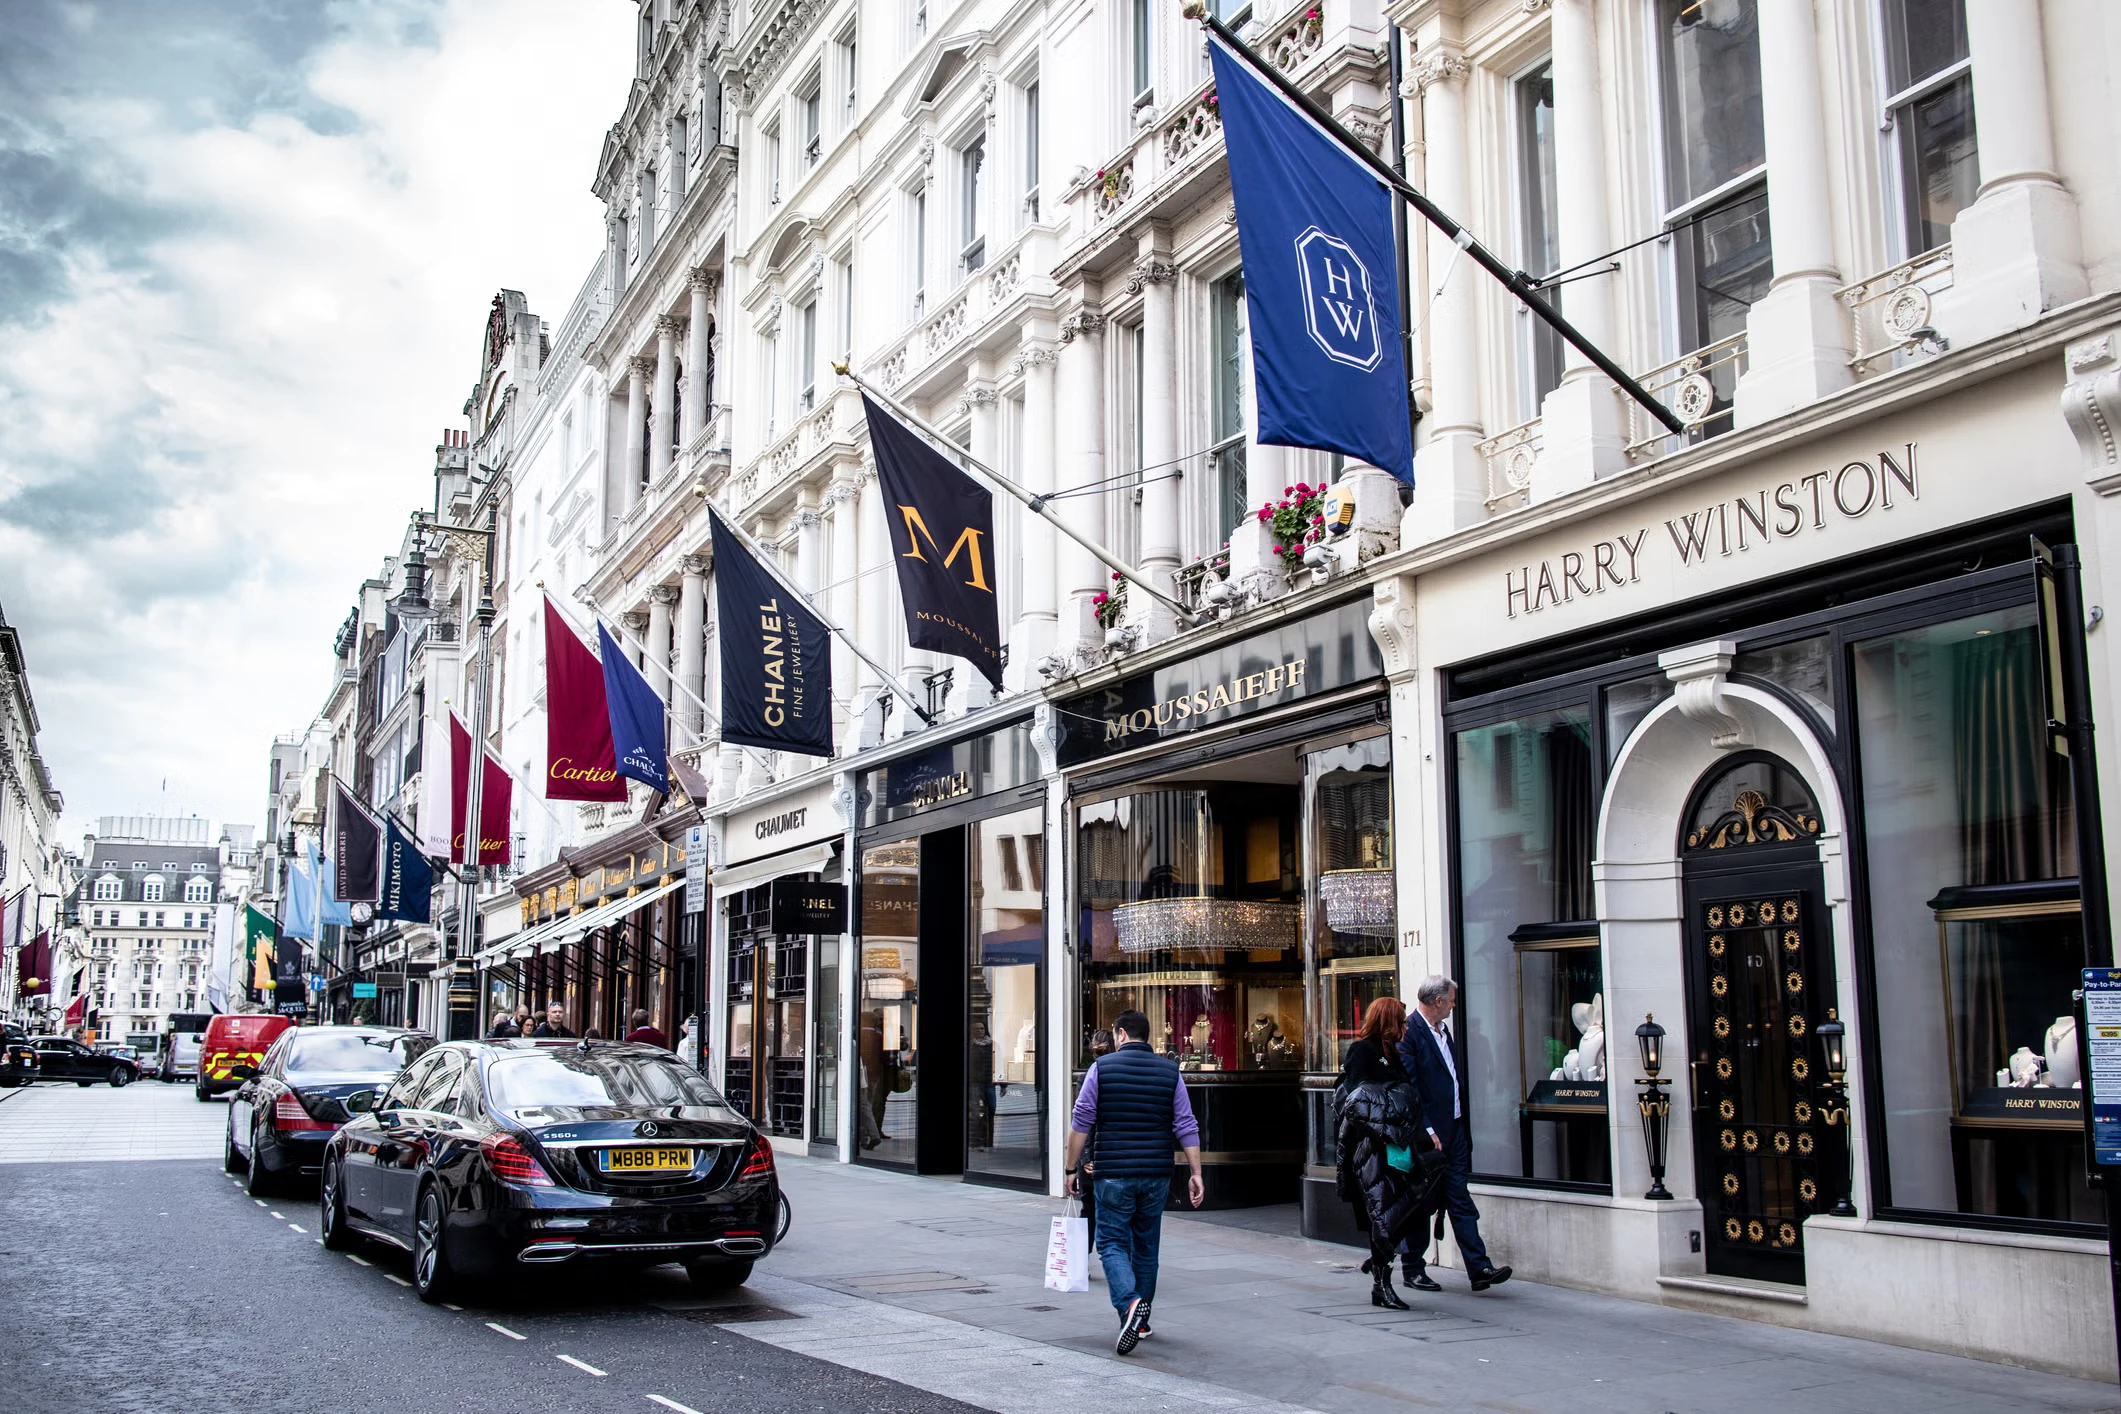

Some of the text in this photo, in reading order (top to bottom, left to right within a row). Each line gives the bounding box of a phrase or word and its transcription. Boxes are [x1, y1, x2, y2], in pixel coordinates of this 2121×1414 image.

[1506, 441, 1920, 619] HARRY WINSTON
[897, 504, 993, 594] M
[916, 611, 998, 660] MOUSSAIFF
[760, 599, 785, 727] CHANEL
[786, 613, 804, 718] FINE JEWELLERY
[1104, 658, 1307, 743] MOUSSAIEFF
[550, 757, 617, 782] Cartier
[912, 771, 968, 808] CHANEL
[453, 833, 506, 851] Ctier
[755, 807, 807, 840] CHAUMET
[388, 841, 402, 912] MIKIMOTO
[1403, 930, 1421, 947] 171
[1555, 1089, 1600, 1097] HARRY WINSTON
[2005, 1099, 2080, 1109] HARRY WINSTON
[613, 1151, 689, 1167] M888 PRM
